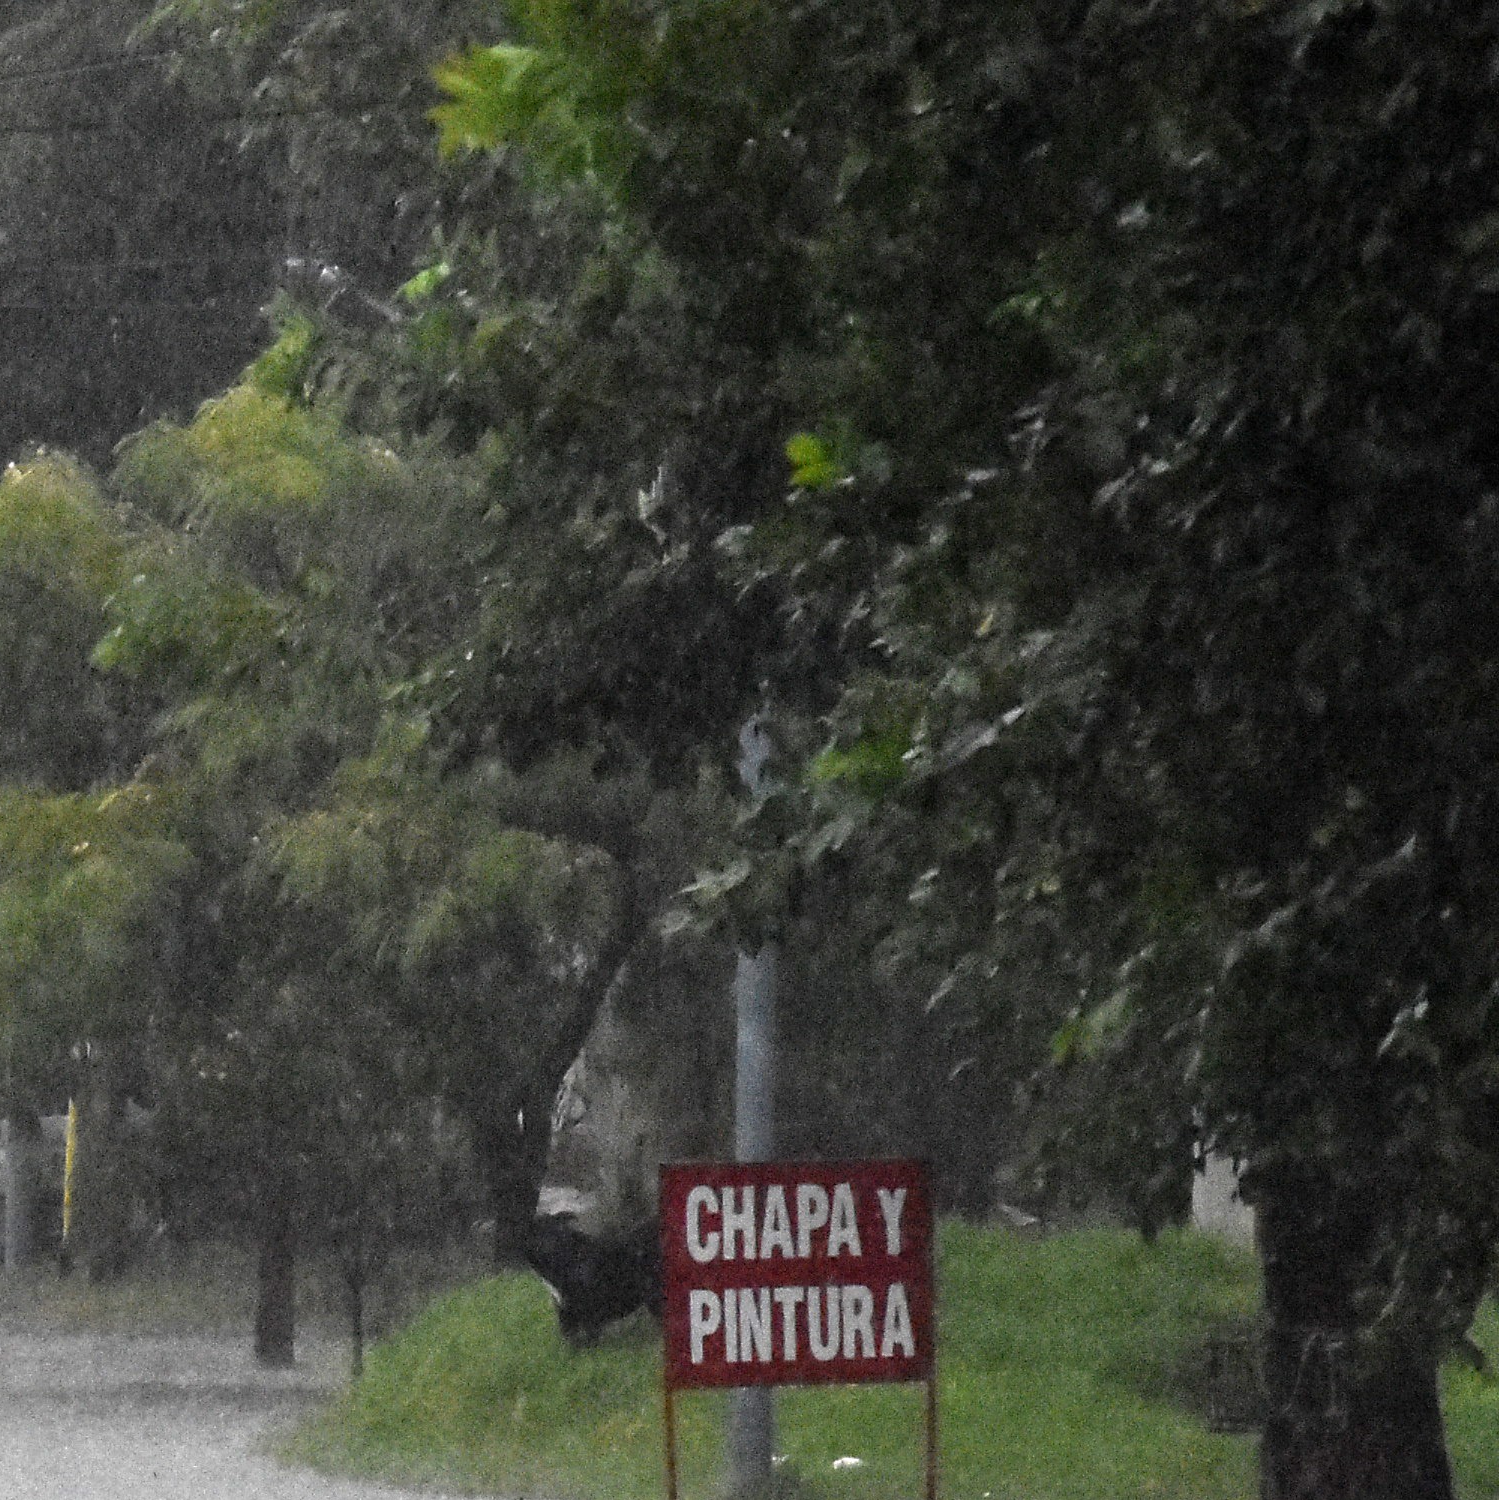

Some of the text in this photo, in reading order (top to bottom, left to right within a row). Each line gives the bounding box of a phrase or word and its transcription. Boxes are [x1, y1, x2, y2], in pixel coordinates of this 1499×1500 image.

[685, 1182, 907, 1263] CHAPA Y
[689, 1282, 915, 1364] PINTURA
